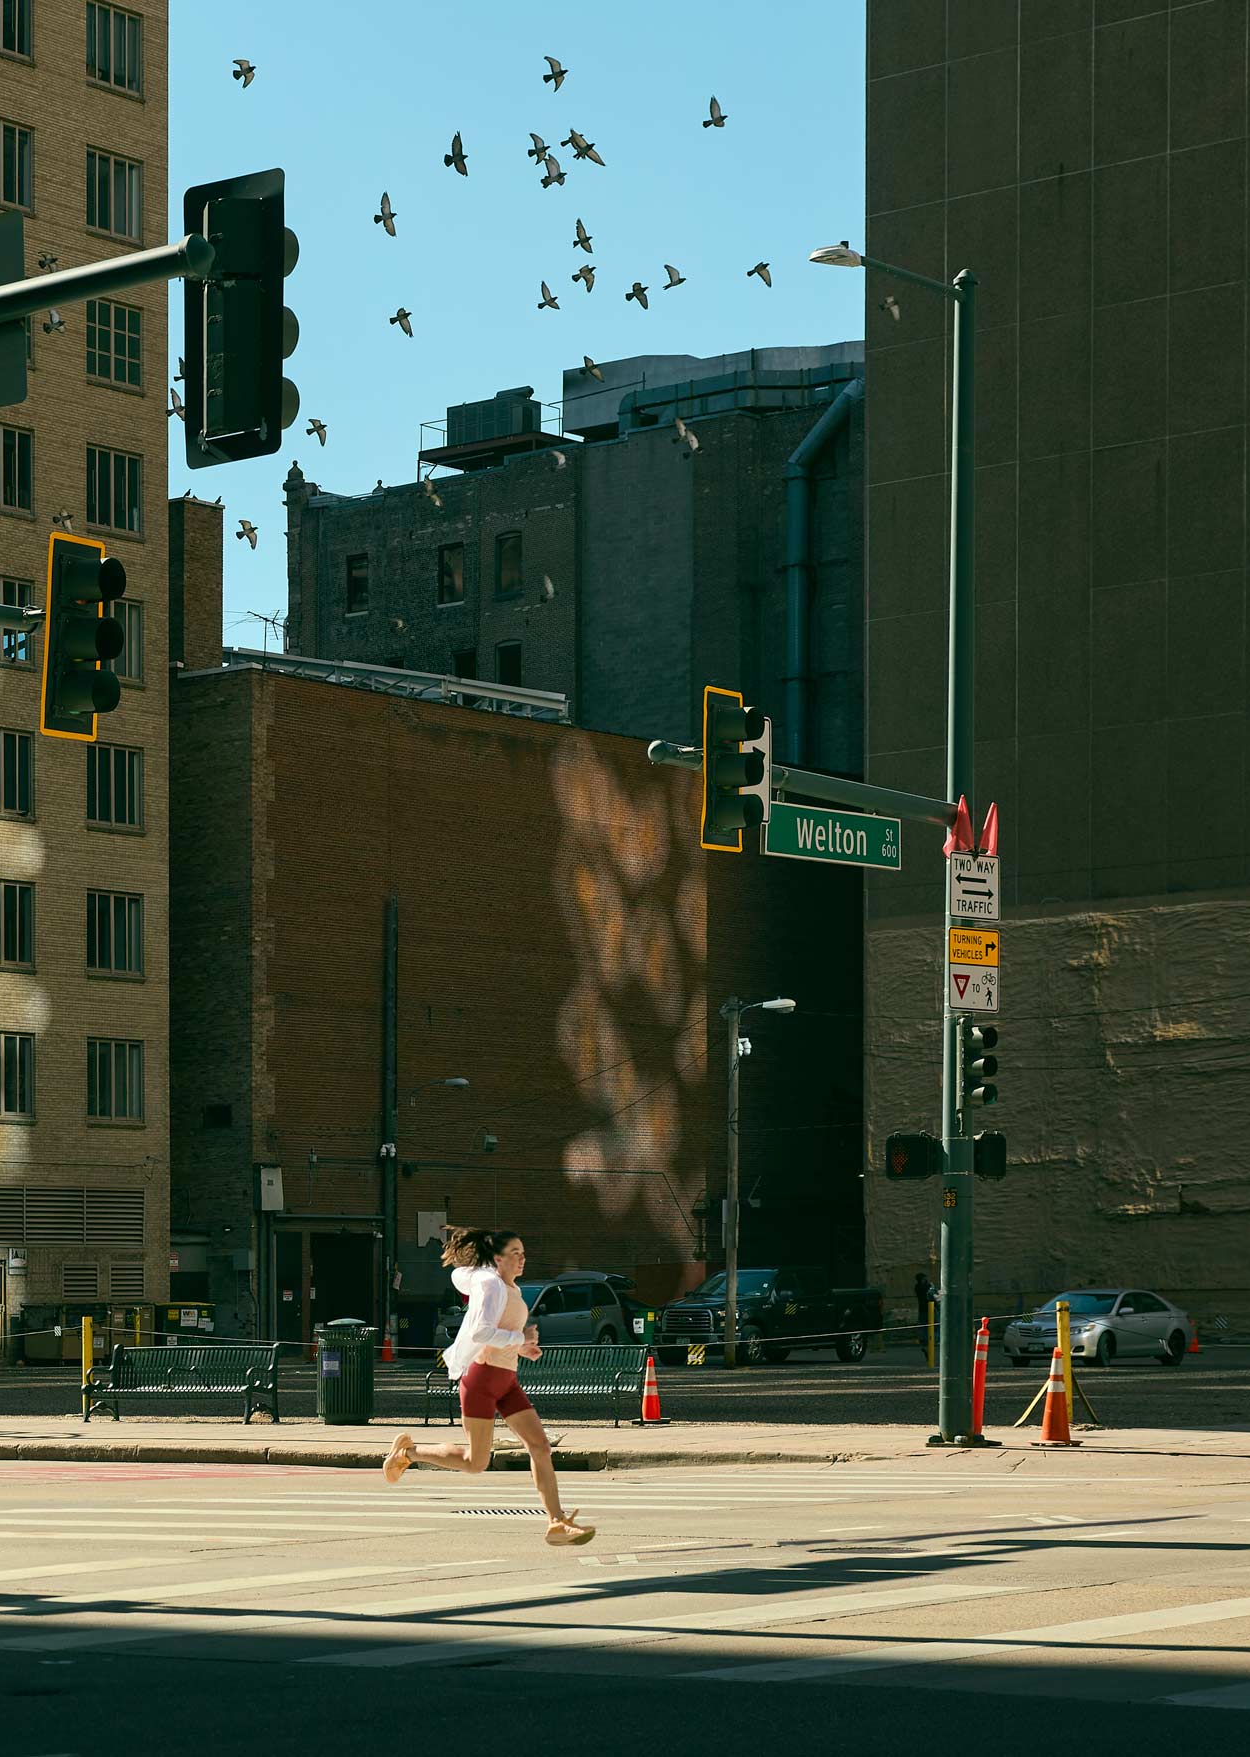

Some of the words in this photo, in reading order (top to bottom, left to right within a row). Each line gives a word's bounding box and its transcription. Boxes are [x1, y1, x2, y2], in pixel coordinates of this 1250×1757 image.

[796, 816, 867, 856] Welton
[885, 828, 893, 842] St
[881, 844, 897, 858] 600
[954, 858, 972, 872] TWO
[976, 860, 996, 875] WAY
[956, 899, 993, 915] TRAFFIC
[953, 933, 982, 945] TURNING
[952, 948, 983, 961] VEHICLES
[971, 983, 981, 993] TO
